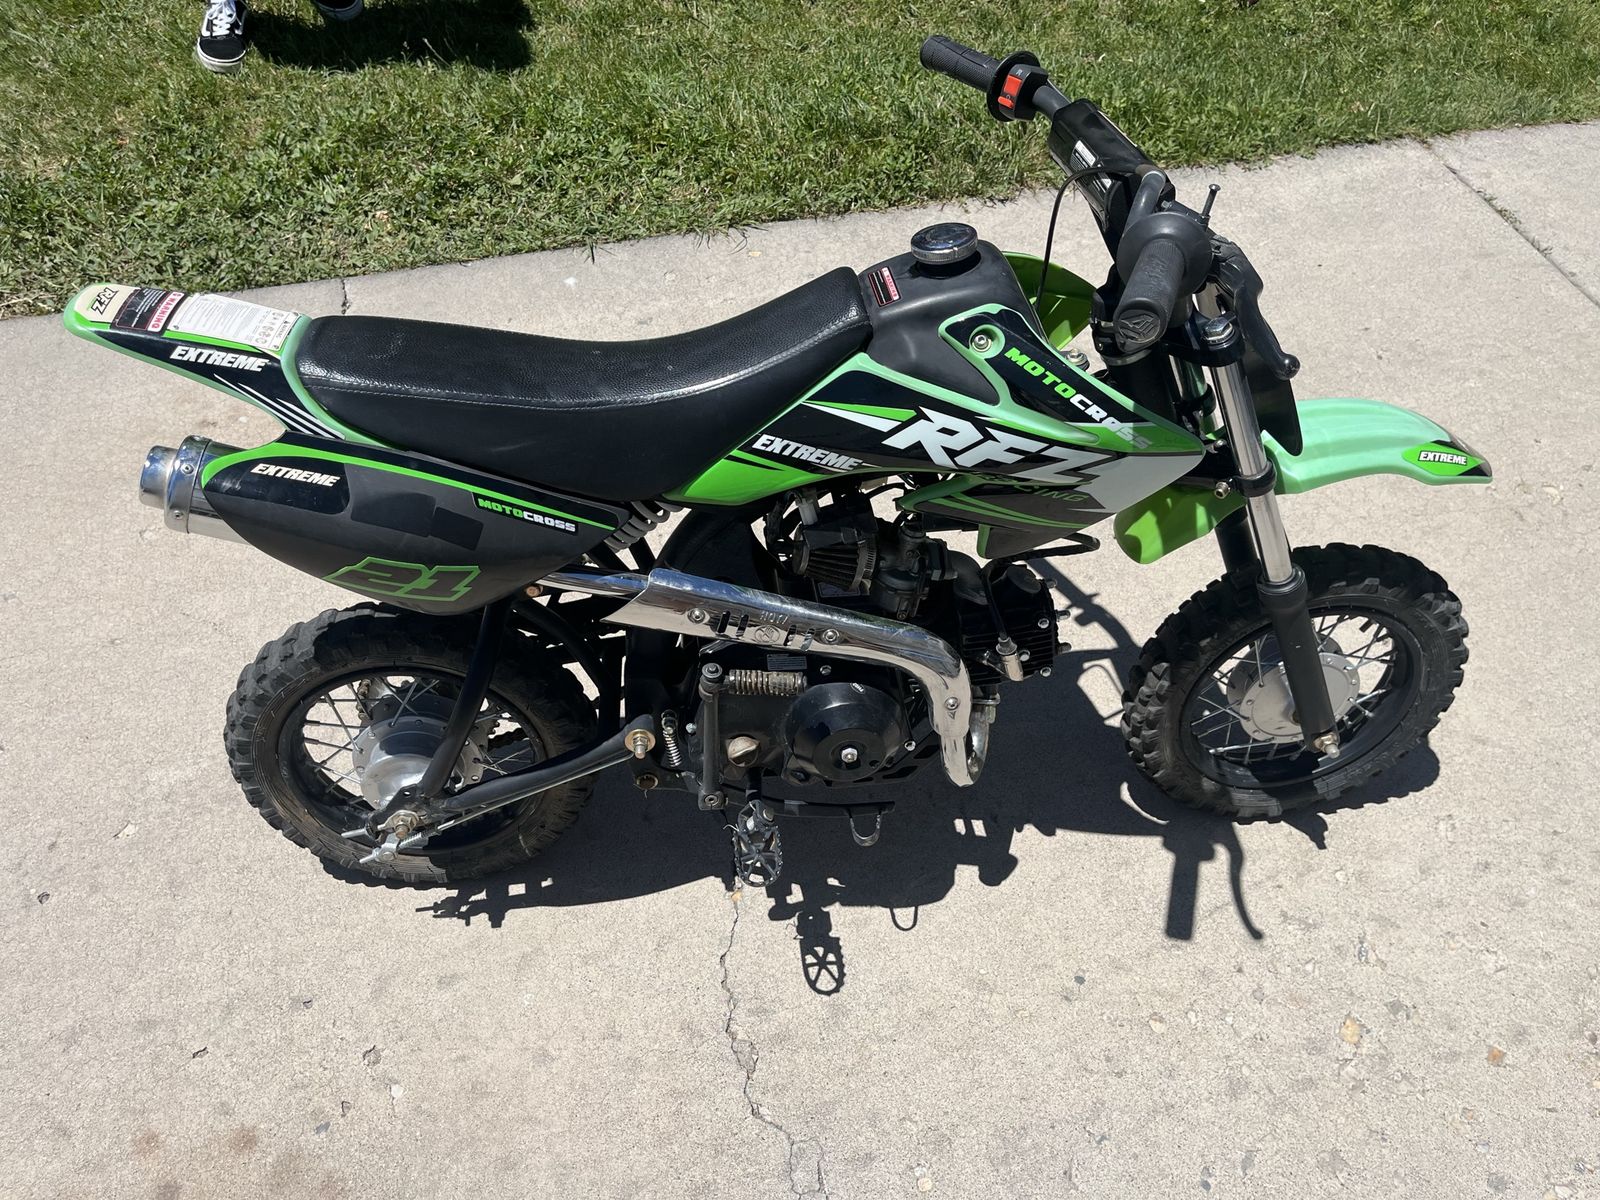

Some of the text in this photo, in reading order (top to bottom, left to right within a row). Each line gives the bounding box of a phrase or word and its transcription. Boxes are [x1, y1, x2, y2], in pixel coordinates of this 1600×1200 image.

[91, 287, 119, 315] RFZ
[169, 345, 270, 372] EXTREME
[1004, 347, 1149, 450] MOTOCROSS
[752, 434, 865, 471] EXTREME
[881, 406, 1112, 483] RFZ
[1419, 451, 1467, 465] EXTREME
[251, 463, 341, 487] EXTREME
[478, 498, 576, 532] MOTOCROSS
[322, 556, 481, 602] 21
